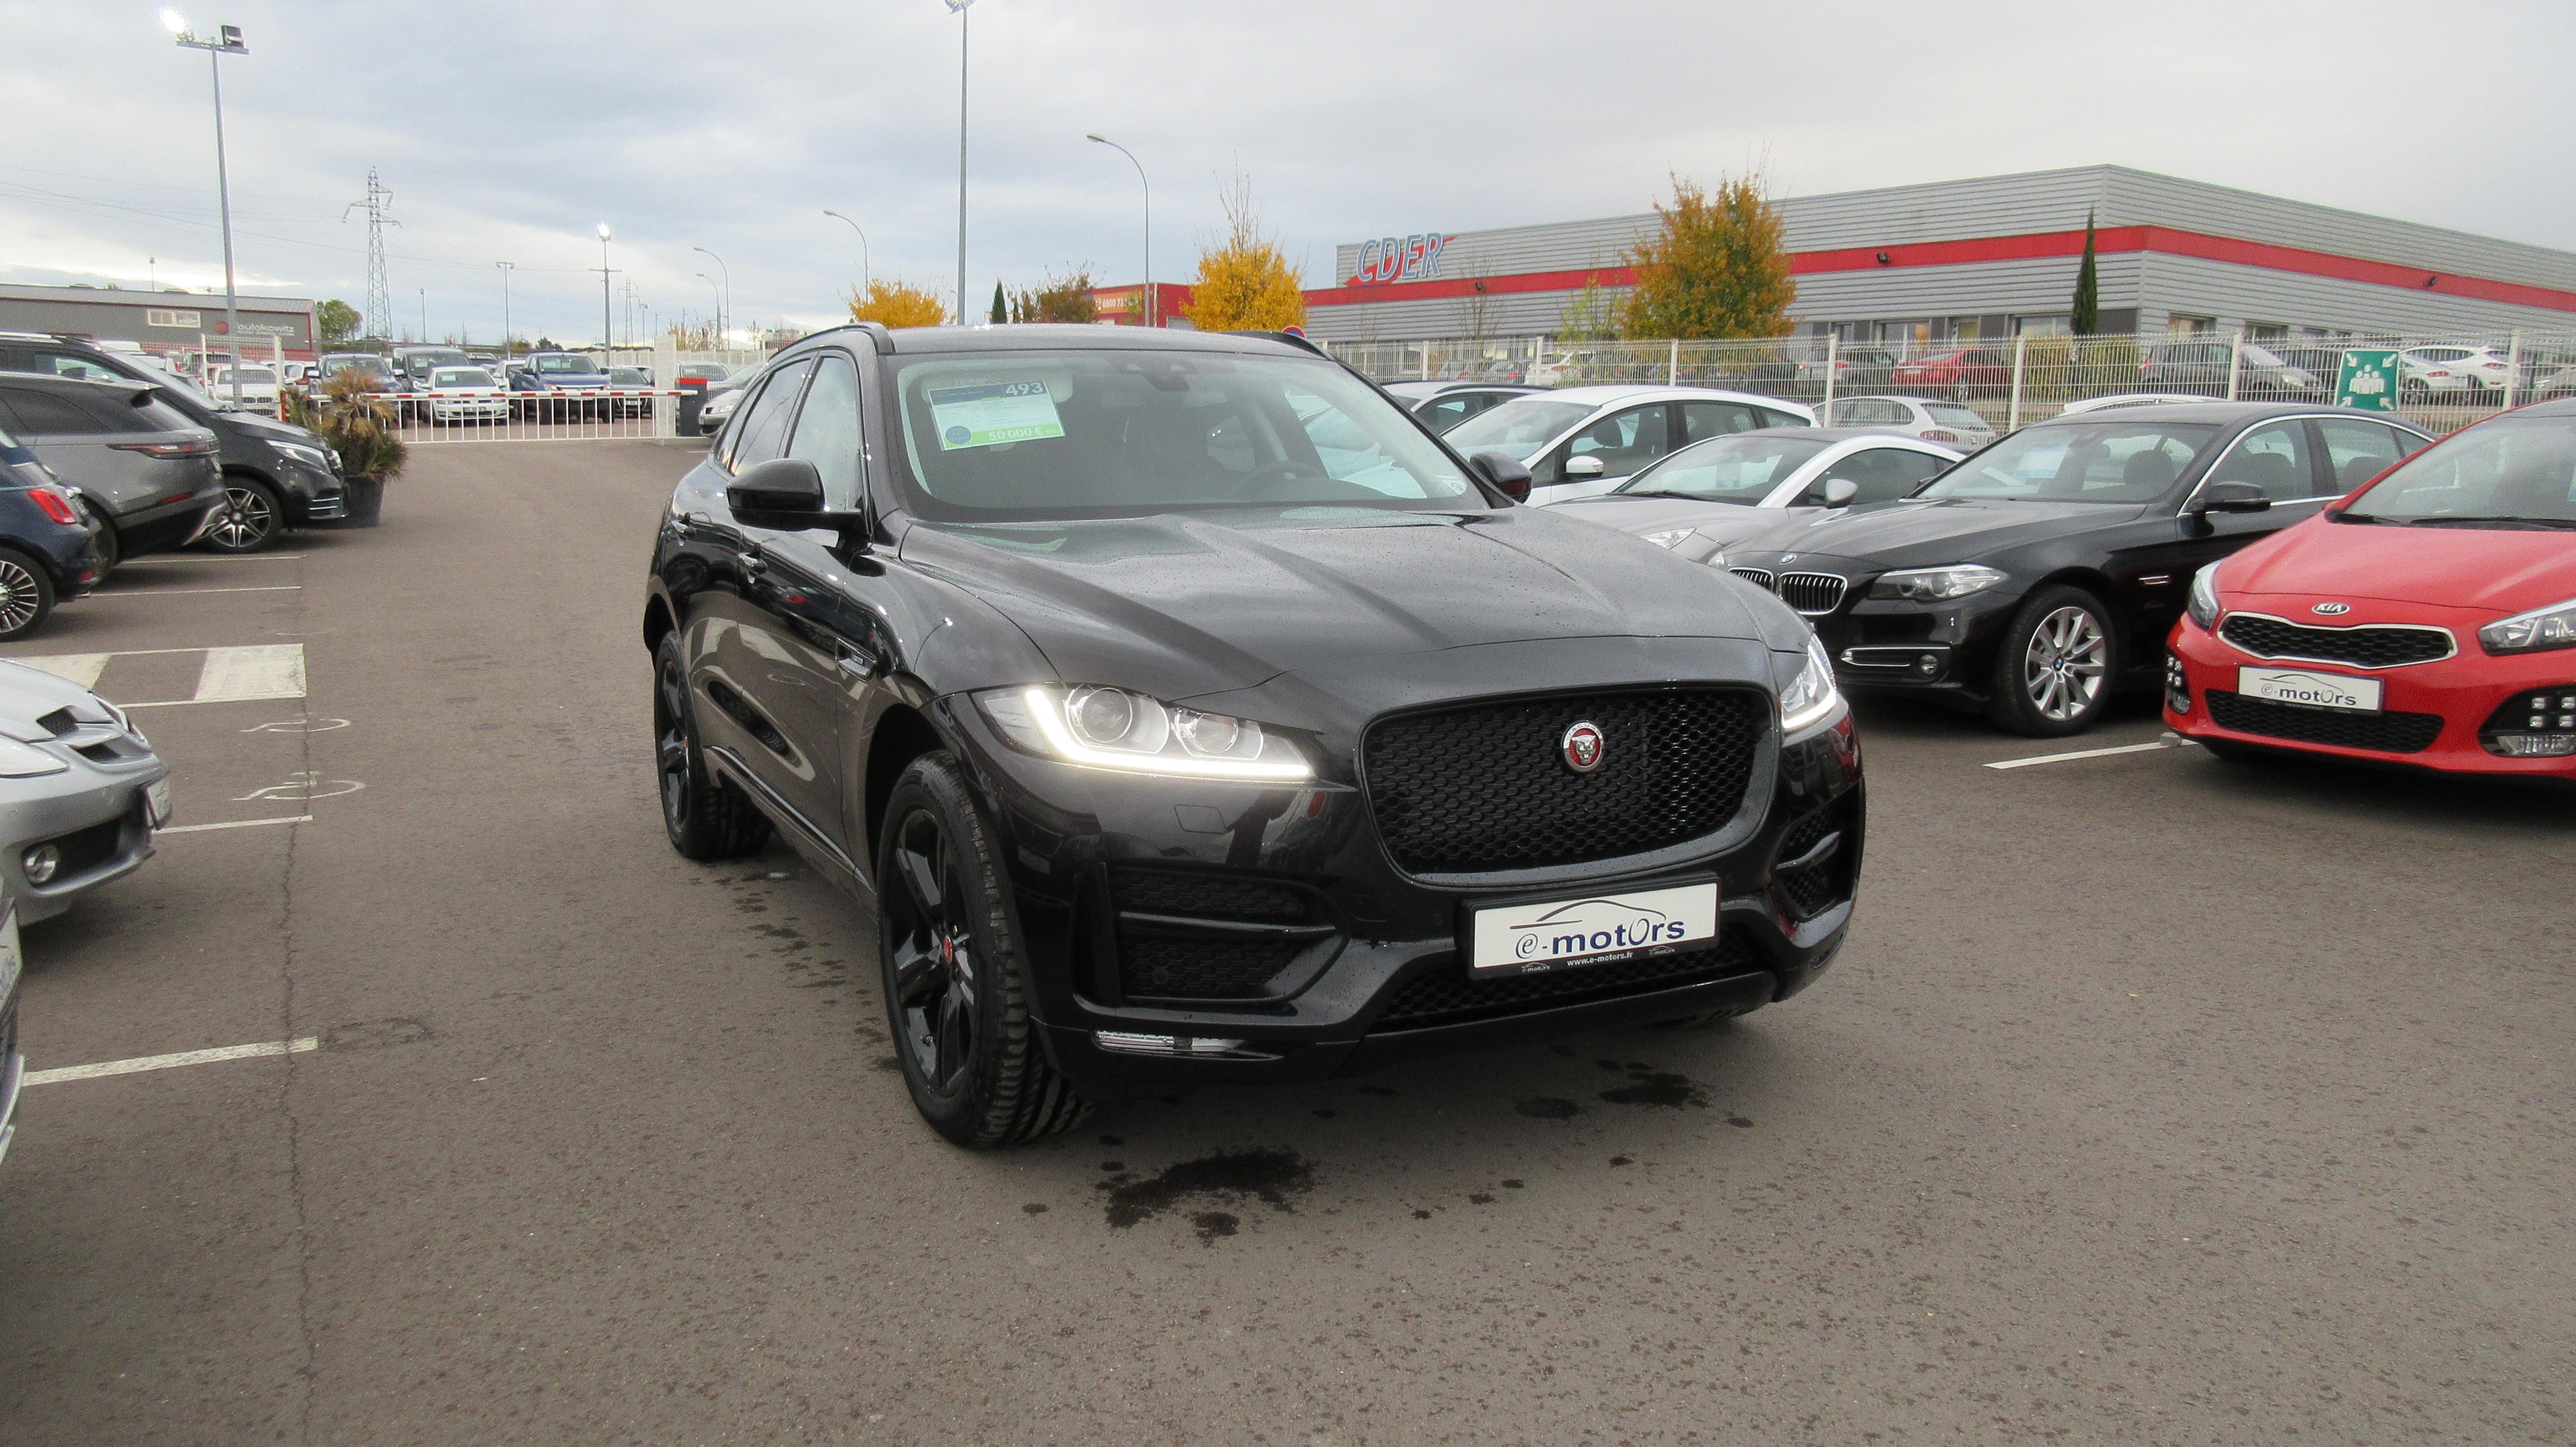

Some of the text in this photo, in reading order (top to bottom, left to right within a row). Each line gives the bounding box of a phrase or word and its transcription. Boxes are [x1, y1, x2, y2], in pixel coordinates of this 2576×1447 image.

[1356, 232, 1444, 282] CDER
[1005, 382, 1043, 396] 493
[989, 429, 1005, 441] 50
[2316, 603, 2342, 612] KIA
[1568, 724, 1601, 736] JAGUAR
[1567, 951, 1633, 966] www.e-motors.fr
